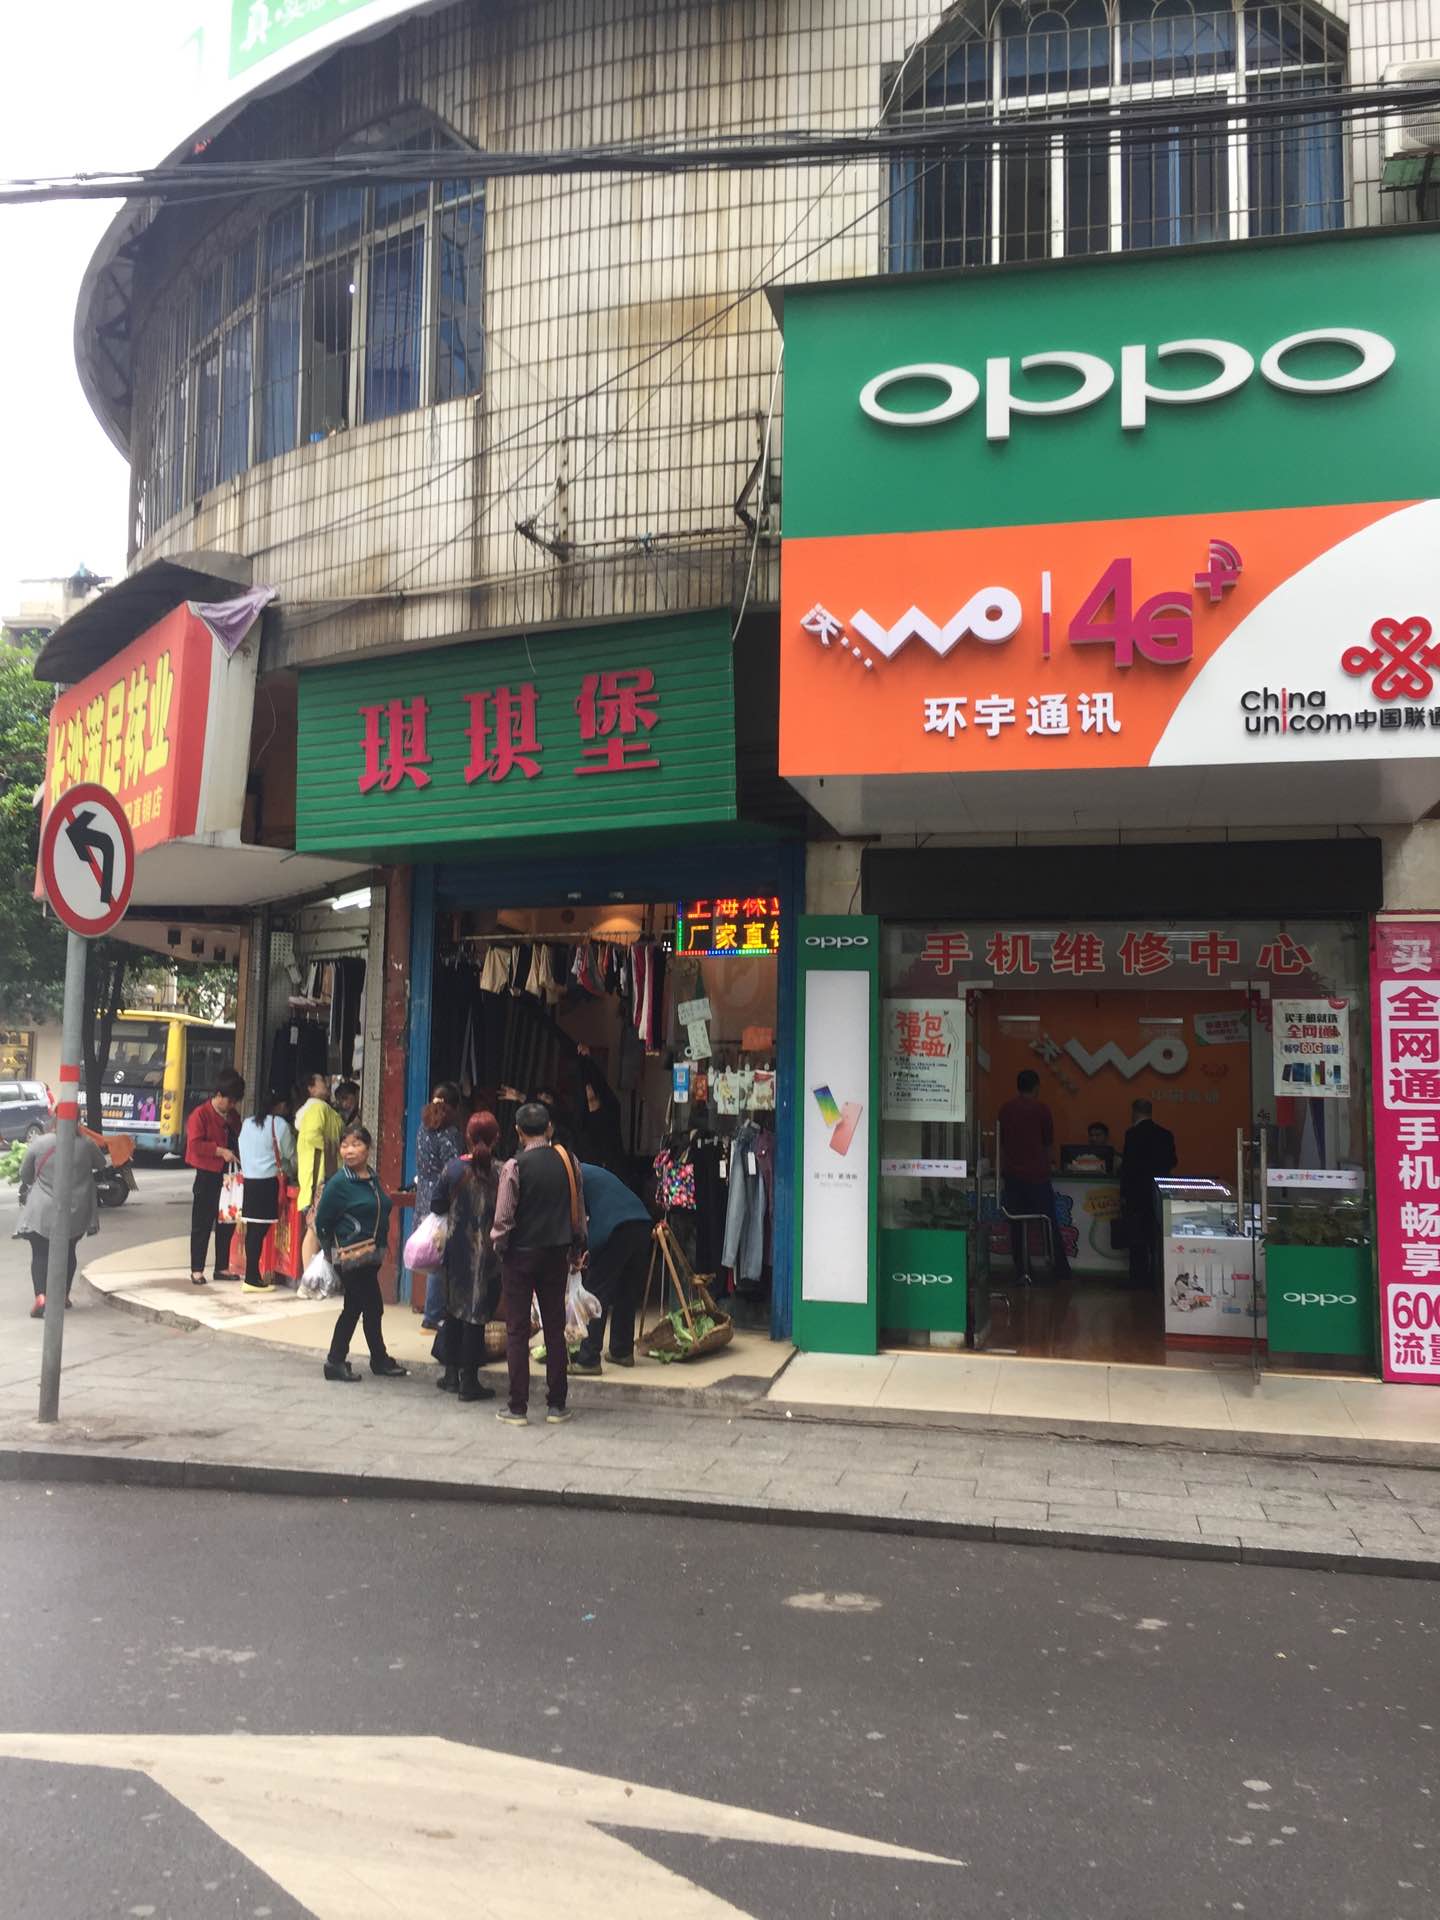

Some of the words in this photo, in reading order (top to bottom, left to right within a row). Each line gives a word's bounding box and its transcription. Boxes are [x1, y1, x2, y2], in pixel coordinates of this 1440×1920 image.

[358, 667, 661, 795] 琪琪堡
[924, 693, 1122, 738] 环宇通讯
[1244, 712, 1353, 735] unicom
[921, 931, 1313, 976] 手机维修中心
